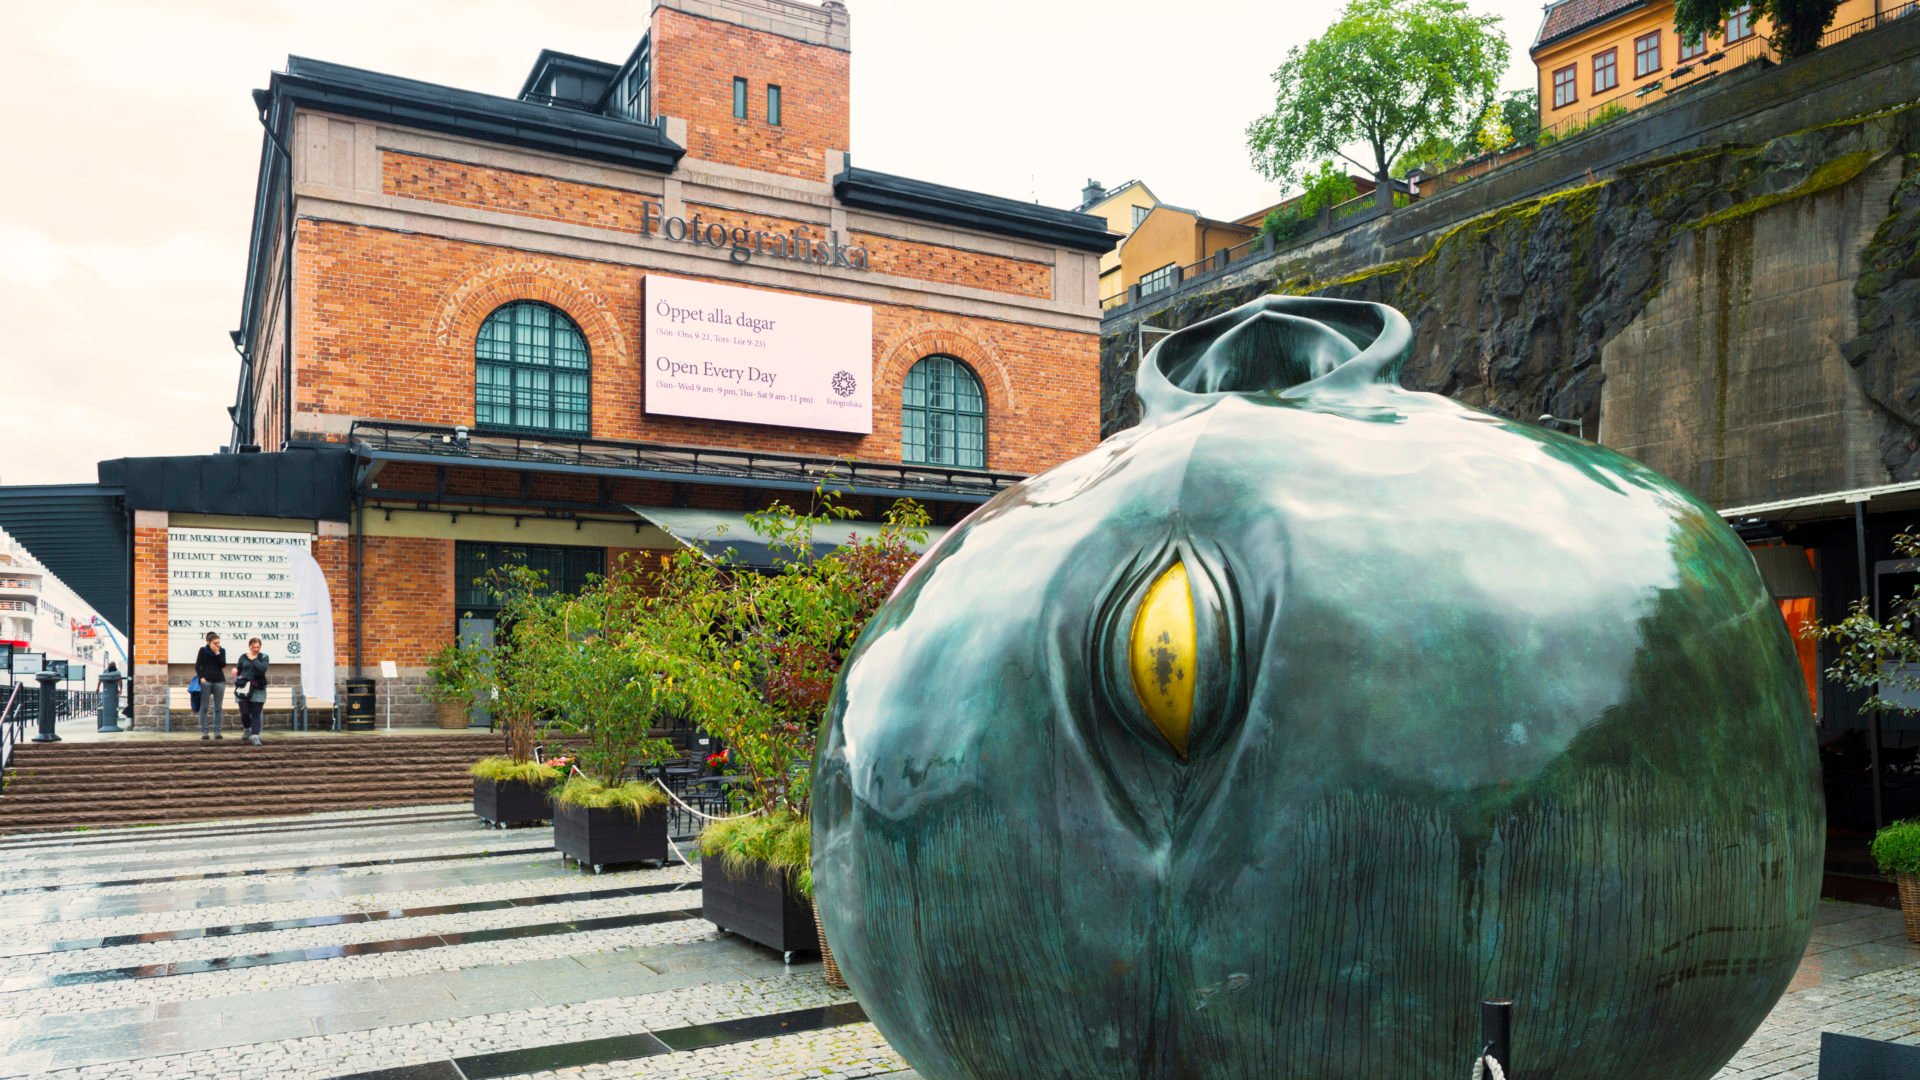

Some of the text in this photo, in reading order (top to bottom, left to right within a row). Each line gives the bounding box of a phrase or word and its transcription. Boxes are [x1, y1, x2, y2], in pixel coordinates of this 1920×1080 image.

[642, 201, 870, 269] Fotografiska
[656, 299, 776, 333] Öppet alla dagar
[656, 356, 777, 387] Open Every Day
[168, 533, 187, 541] THE
[189, 534, 228, 543] MUSEUM
[243, 536, 307, 546] PHOTOGRAPHY
[172, 552, 215, 561] HELMUT
[220, 554, 263, 562] NEWTON
[173, 571, 211, 579] PIETER
[220, 572, 252, 580] HUGO
[172, 589, 214, 598] MARCUS
[218, 590, 271, 599] BLEASDALE
[168, 620, 192, 628] OPEN
